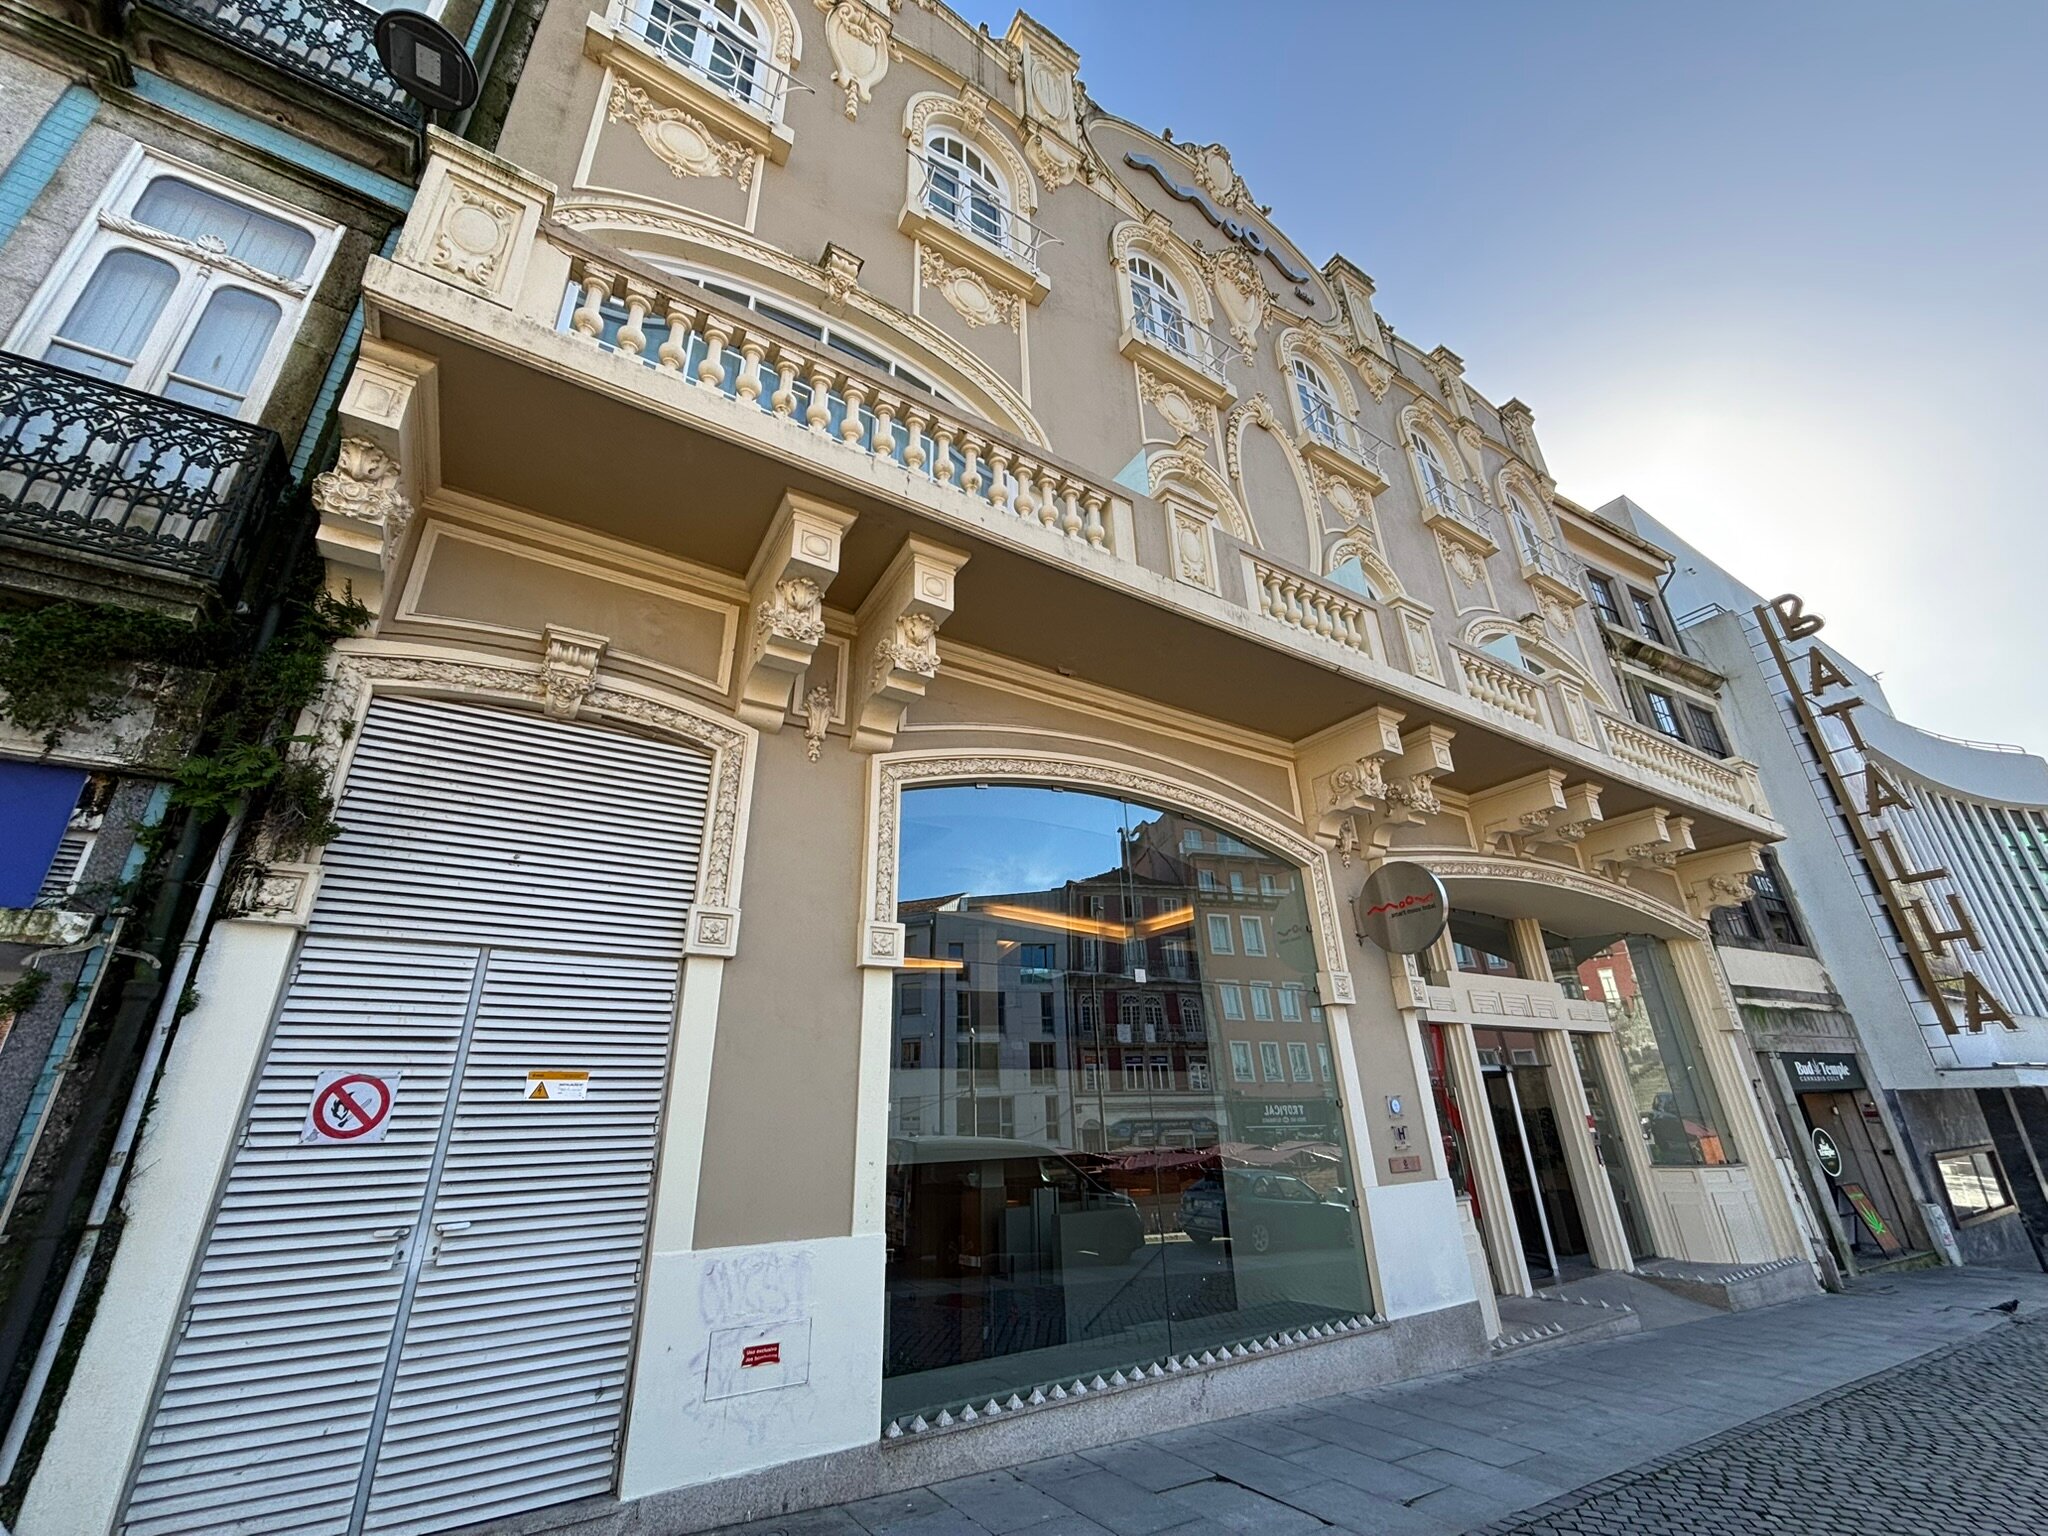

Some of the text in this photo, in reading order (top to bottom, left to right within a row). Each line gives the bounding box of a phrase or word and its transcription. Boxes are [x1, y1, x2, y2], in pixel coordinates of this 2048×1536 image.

[1771, 592, 2020, 1034] BATALHA
[1794, 1061, 1851, 1081] Bud Temple
